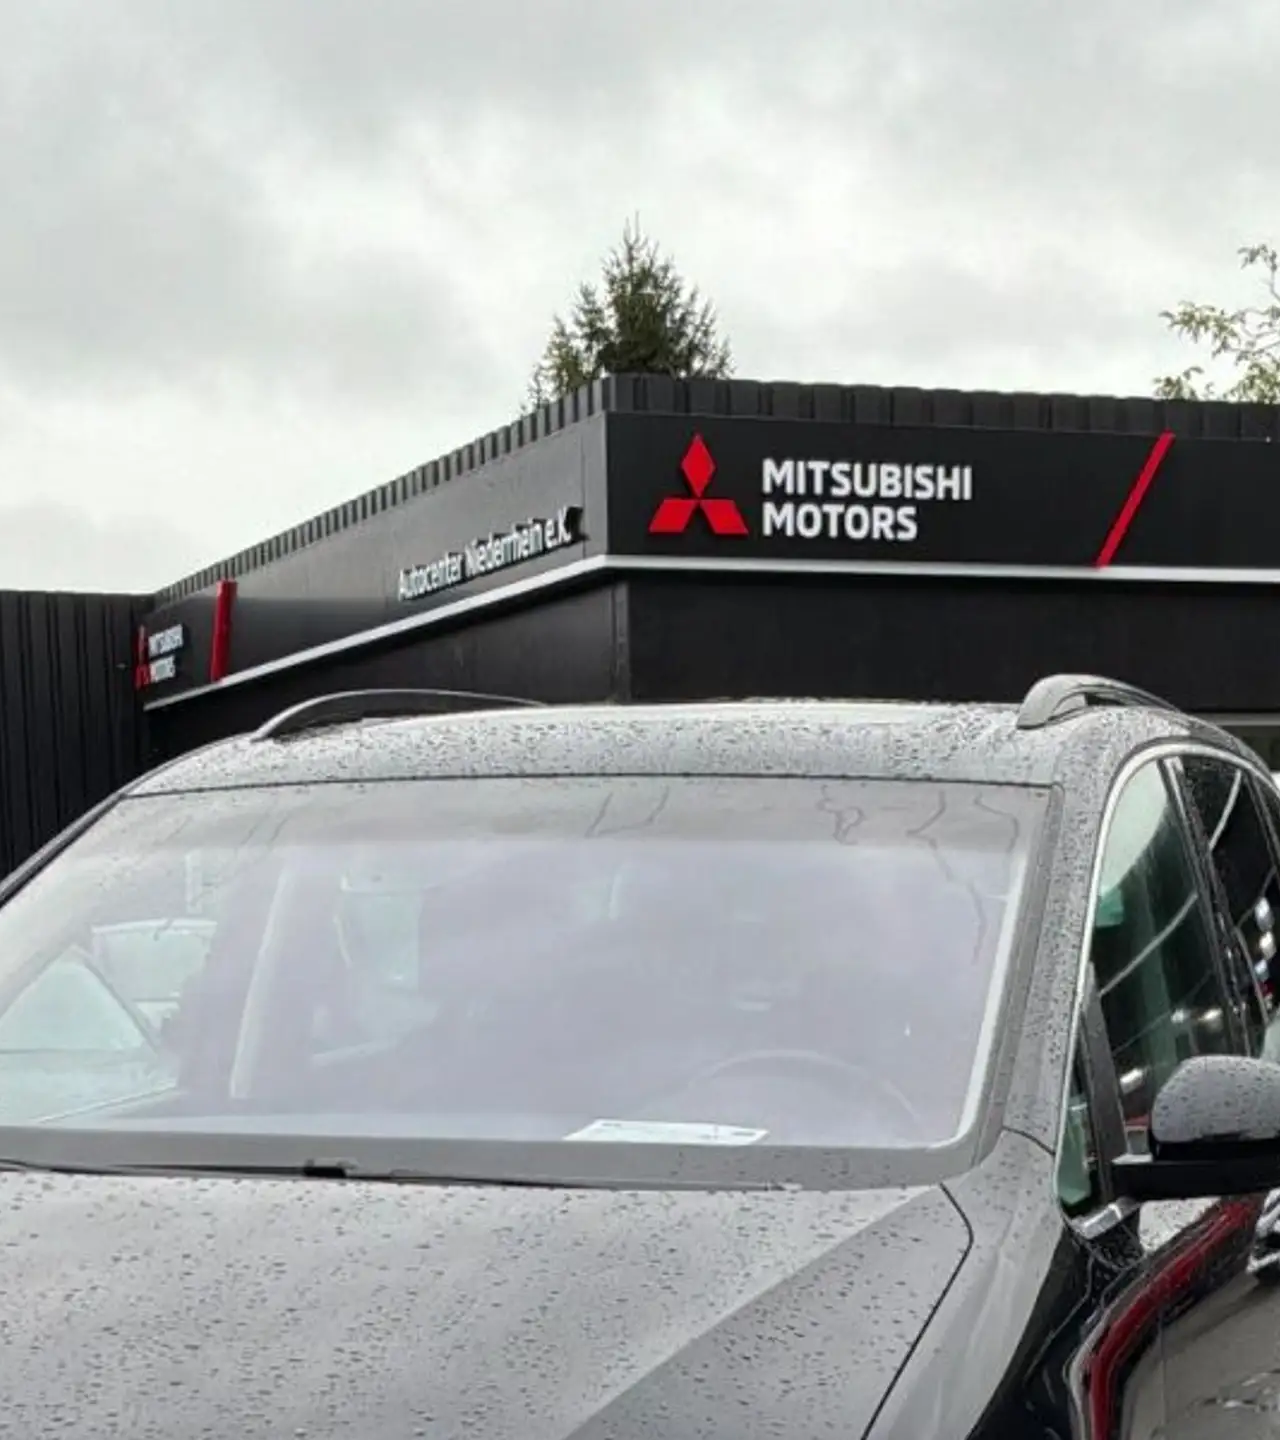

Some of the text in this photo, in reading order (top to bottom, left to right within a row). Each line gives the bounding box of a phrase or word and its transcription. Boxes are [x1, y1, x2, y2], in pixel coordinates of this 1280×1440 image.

[762, 458, 972, 500] MITSUBISHI
[762, 502, 918, 540] MOTORS
[399, 552, 463, 601] Autocenter
[465, 518, 543, 577] Niederrhein
